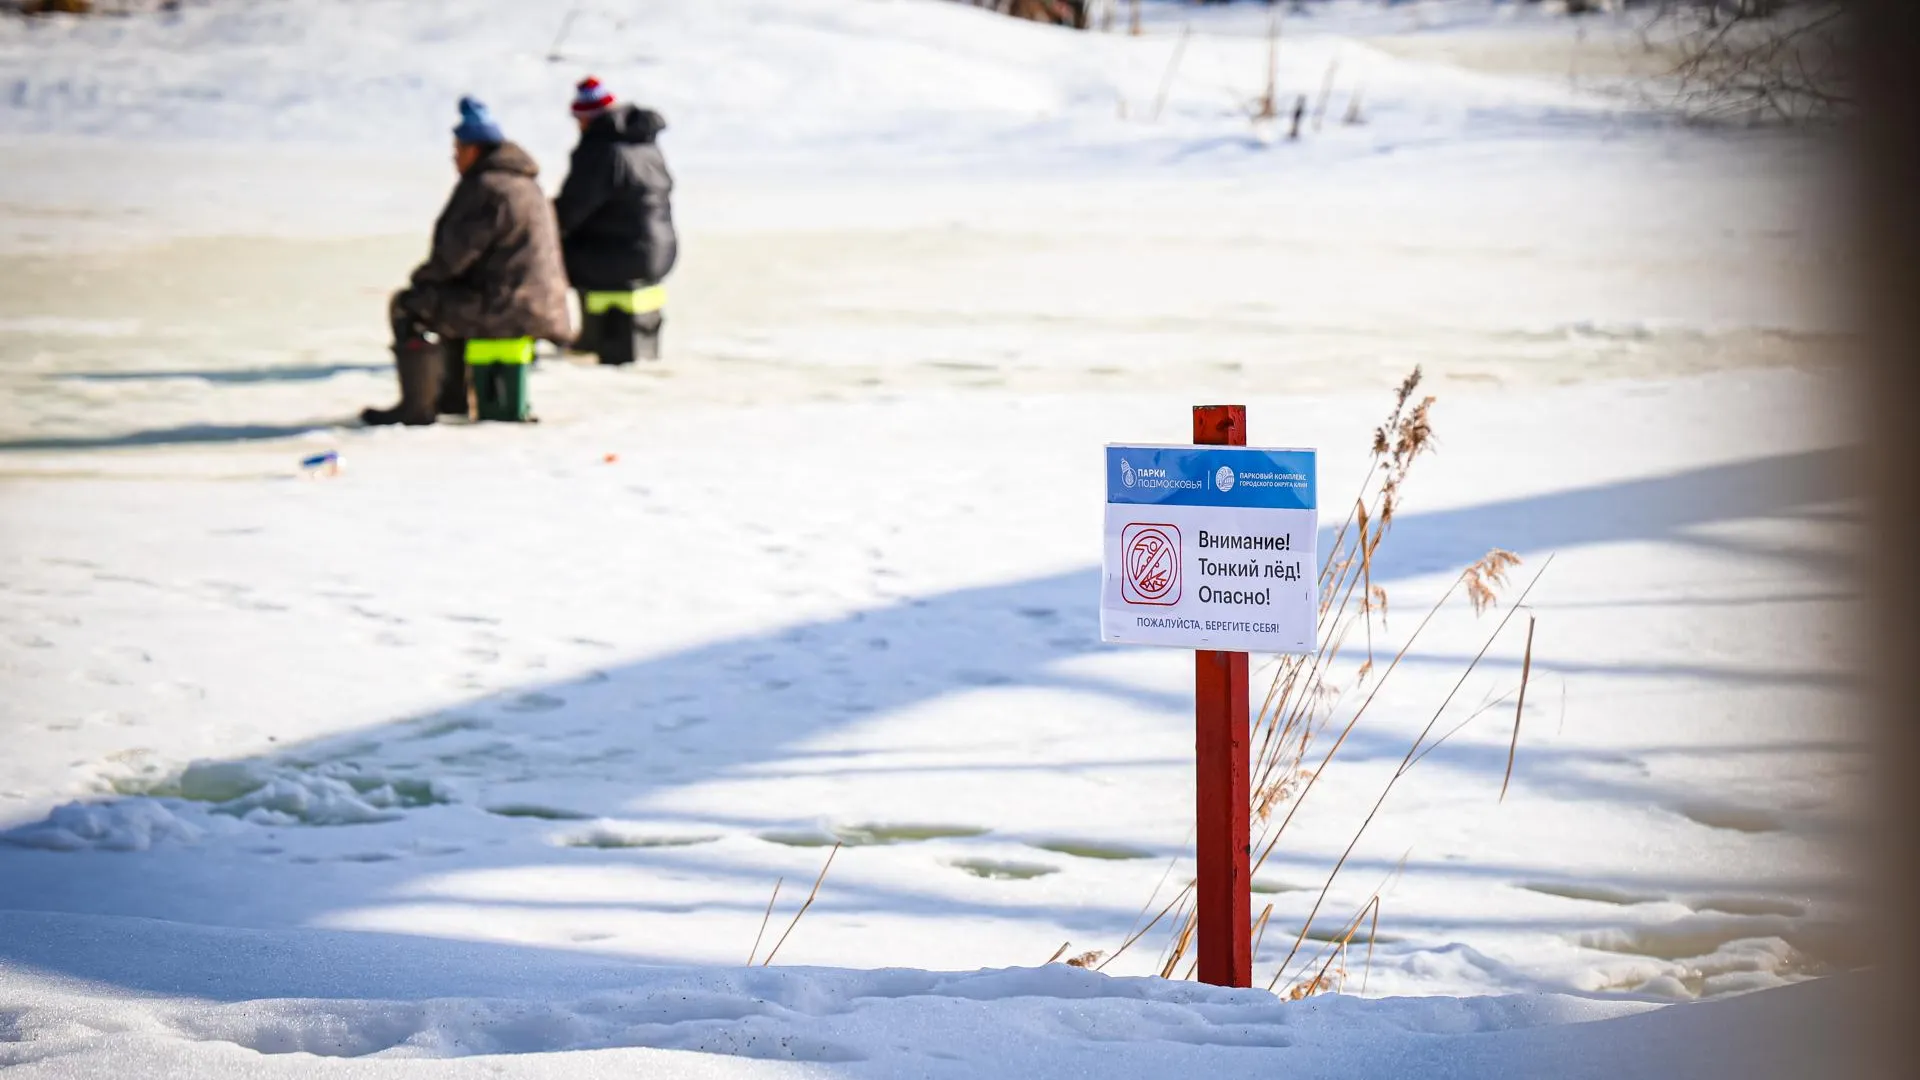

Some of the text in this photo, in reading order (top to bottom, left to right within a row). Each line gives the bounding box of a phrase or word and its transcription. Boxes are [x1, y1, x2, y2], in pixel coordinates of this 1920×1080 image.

[1138, 468, 1166, 478] ПАРКИ
[1239, 472, 1307, 481] ПАРКОВЫЙ КОМПЛЕКС
[1138, 479, 1202, 489] ПОДМОСКОВЬЯ
[1199, 530, 1290, 551] Внимание!
[1199, 558, 1301, 581] Тонкий лёд!
[1199, 585, 1270, 606] Опасно!
[1136, 617, 1279, 633] ПОЖАЛУЙСТА, БЕРЕГИТЕ СЕБЯ!
